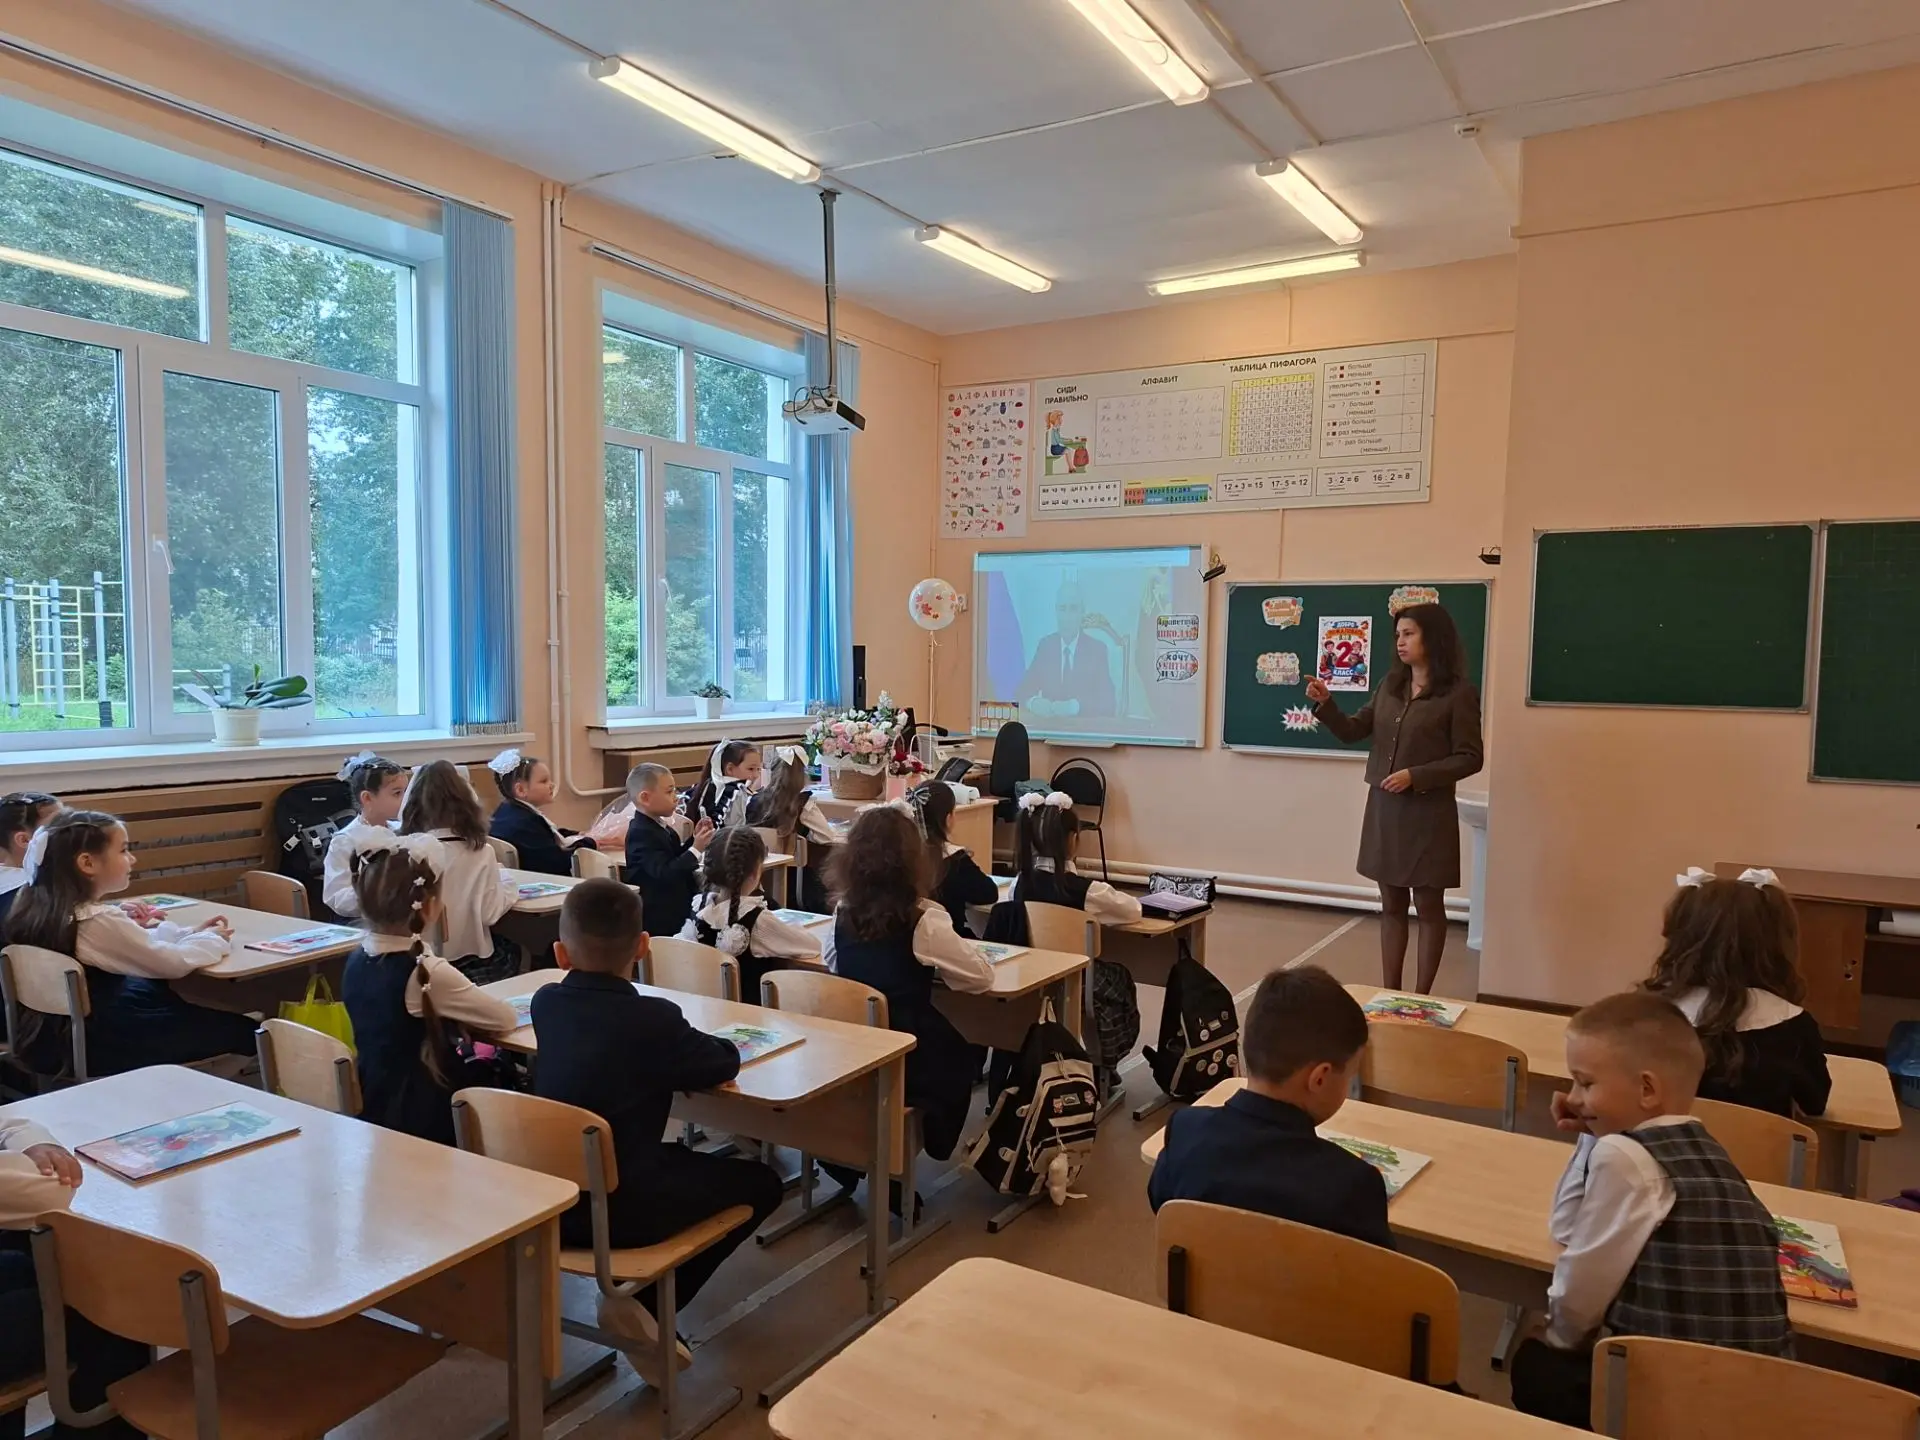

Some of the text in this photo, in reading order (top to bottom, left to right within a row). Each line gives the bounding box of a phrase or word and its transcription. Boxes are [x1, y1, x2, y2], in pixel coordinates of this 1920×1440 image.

[1230, 357, 1317, 373] ТАБЛИЦА ПИФАГОРА
[1141, 375, 1179, 386] АЛФАВИТ
[1056, 386, 1077, 395] СИДИ
[1045, 395, 1088, 405] ПРАВИЛЬНО
[1390, 473, 1395, 481] 2
[1241, 482, 1245, 490] 3
[1255, 481, 1263, 489] 15
[1271, 480, 1280, 488] 17
[1336, 641, 1353, 668] 2
